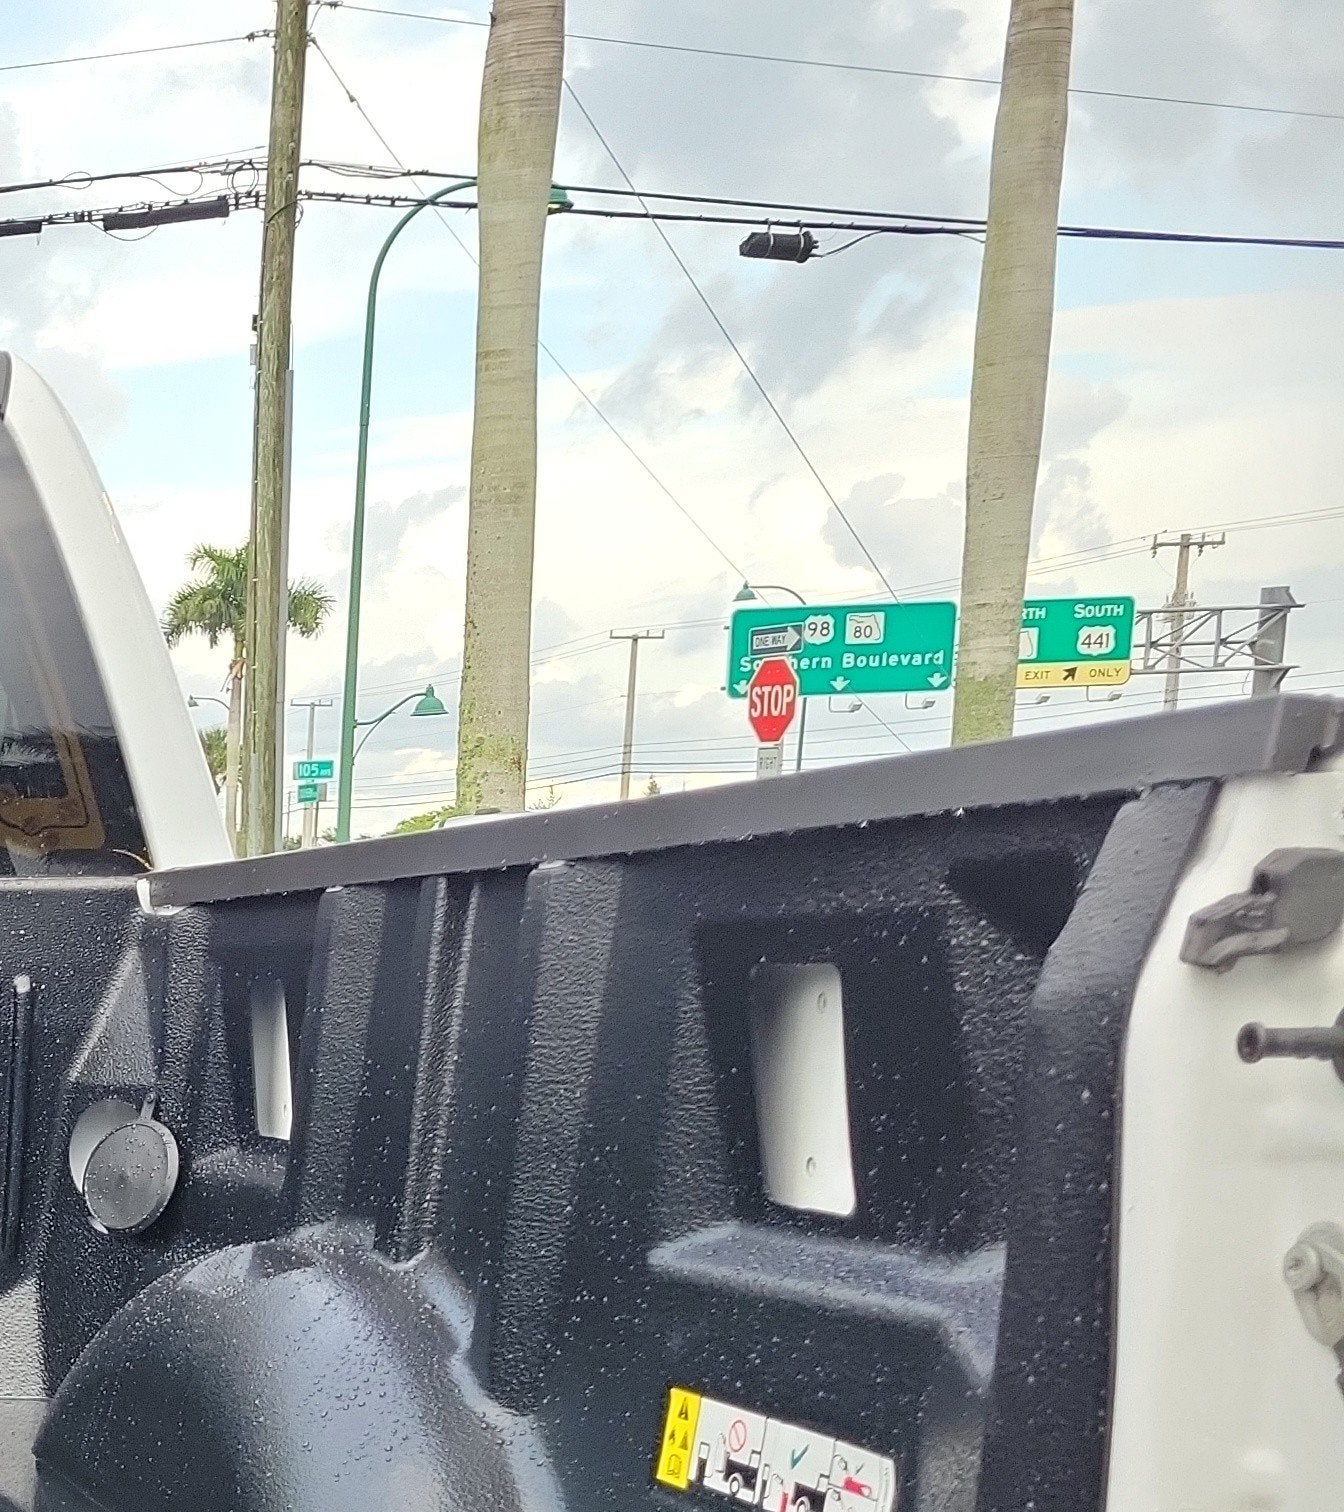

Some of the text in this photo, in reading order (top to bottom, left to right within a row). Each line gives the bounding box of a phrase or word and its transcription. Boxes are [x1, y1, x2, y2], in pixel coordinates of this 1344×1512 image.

[1021, 607, 1047, 620] RTH
[1073, 603, 1124, 619] SOUTH
[807, 621, 830, 637] 98
[853, 625, 873, 639] 80
[755, 634, 787, 648] ONE WAY
[1081, 632, 1109, 649] 441
[739, 650, 945, 672] Sohern Boulevard
[1025, 667, 1123, 681] EXIT ONLY
[751, 684, 795, 718] STOP
[299, 763, 319, 777] 105
